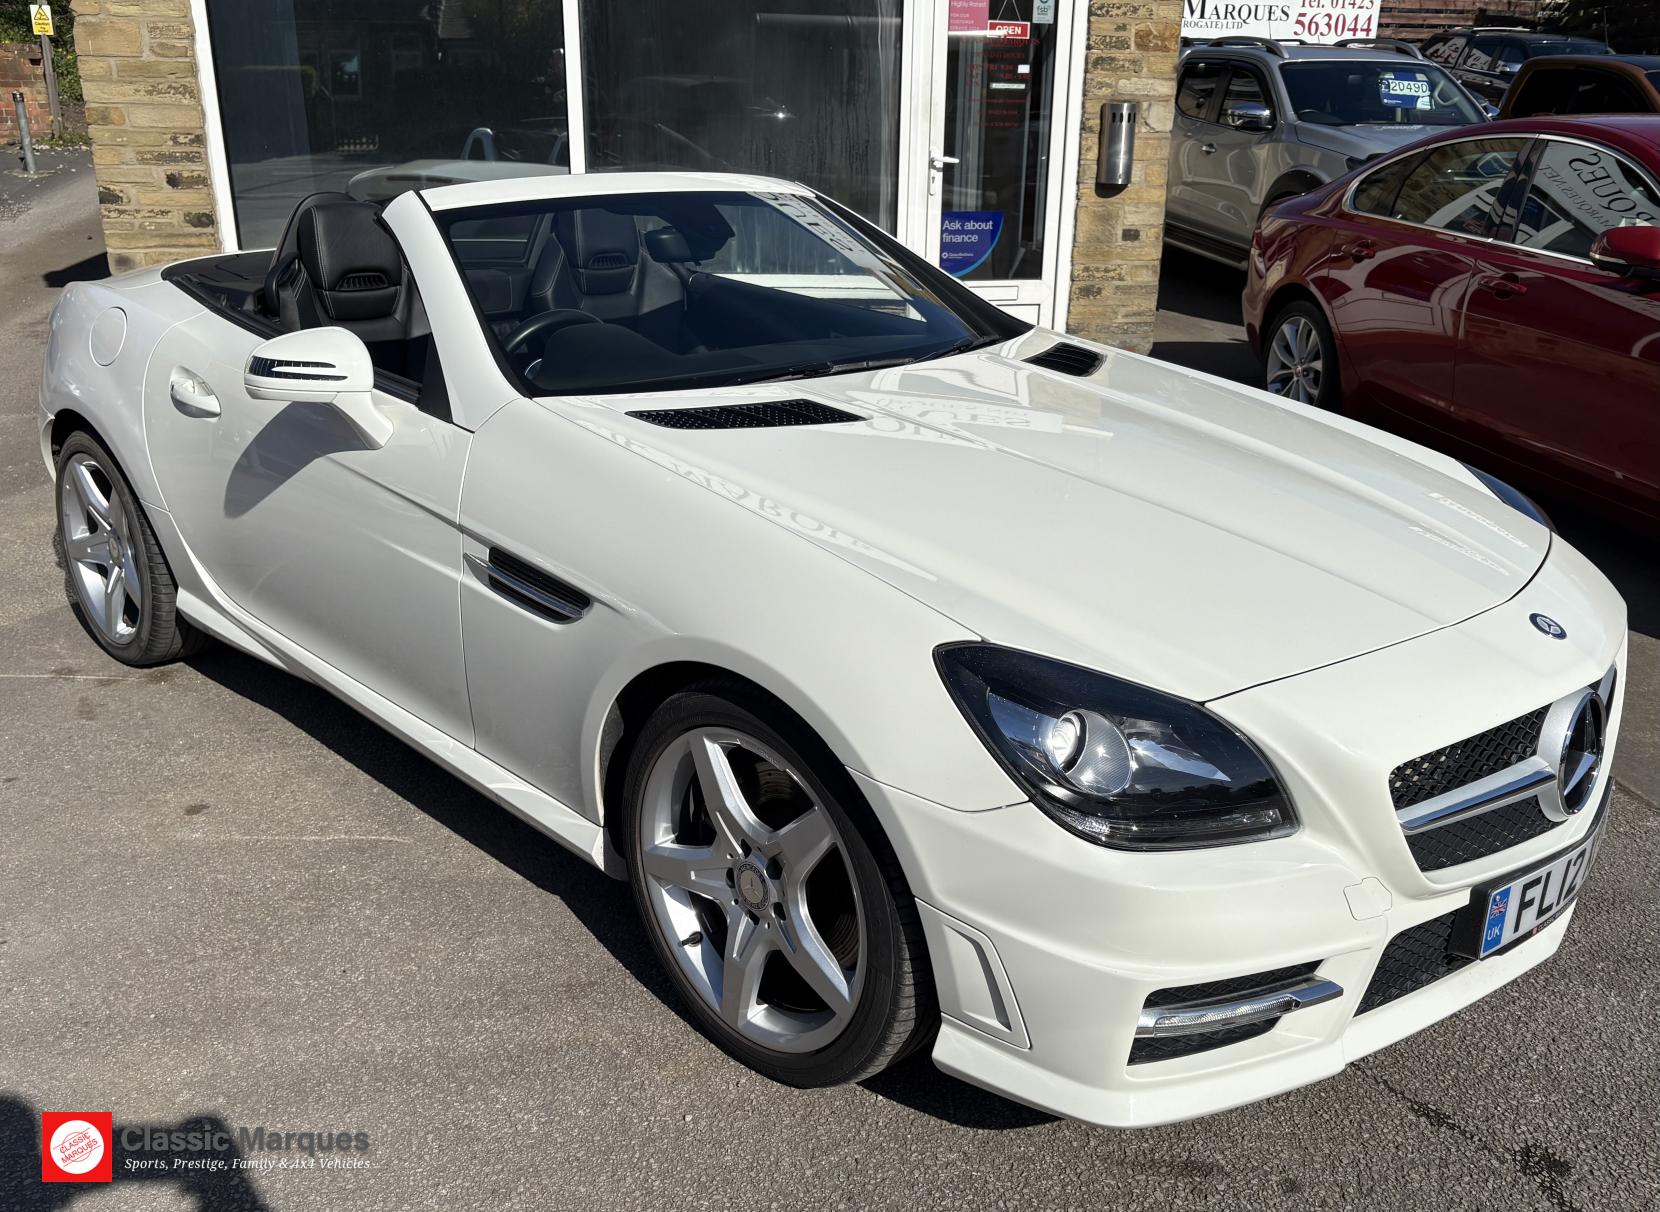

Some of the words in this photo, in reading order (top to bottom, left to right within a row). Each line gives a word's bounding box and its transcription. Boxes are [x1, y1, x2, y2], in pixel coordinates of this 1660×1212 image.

[1182, 0, 1290, 24] MARQUES
[1225, 21, 1243, 29] LTD
[1293, 12, 1373, 37] 563044
[996, 25, 1022, 35] OPEN
[942, 221, 962, 230] Ask
[964, 221, 993, 230] about
[942, 233, 979, 243] finance
[1487, 924, 1501, 941] UK
